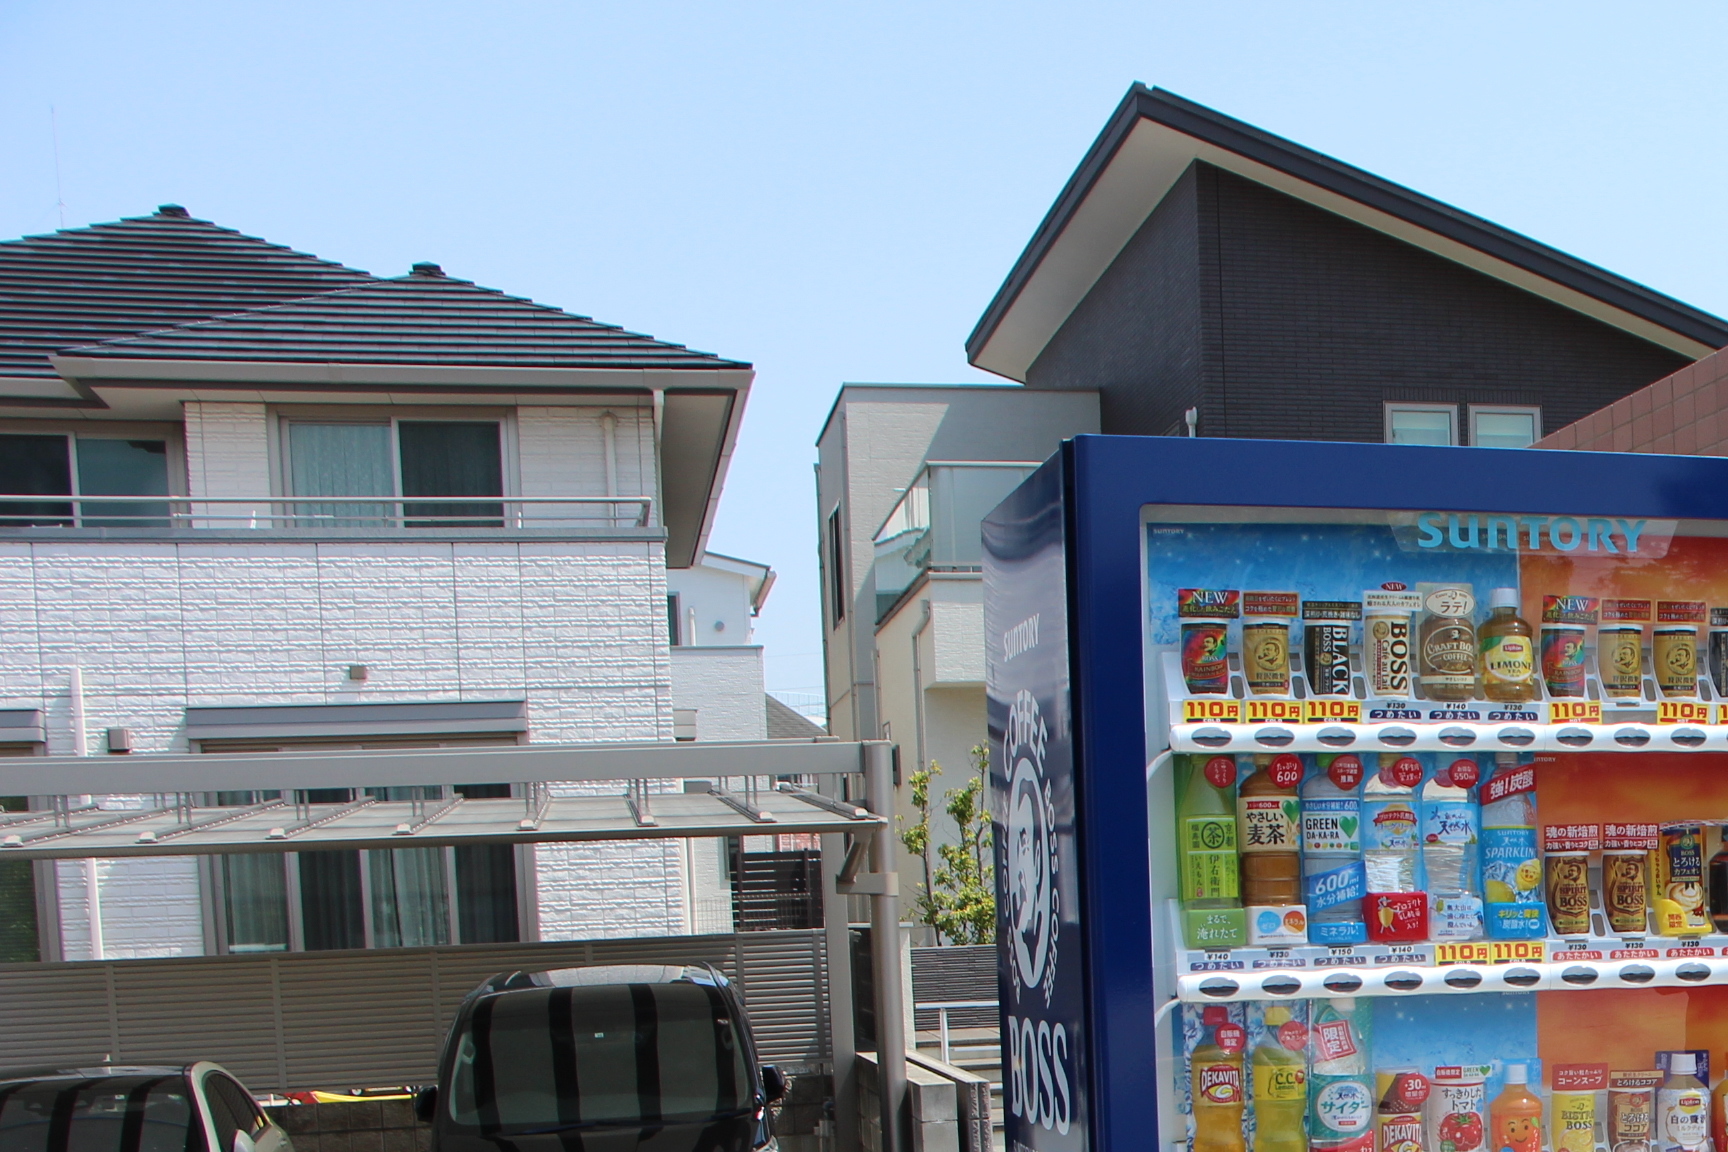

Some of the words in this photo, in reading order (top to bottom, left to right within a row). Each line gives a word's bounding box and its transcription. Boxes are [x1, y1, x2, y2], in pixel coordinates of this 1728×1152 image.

[1417, 512, 1647, 553] SUNTORY
[1386, 583, 1404, 591] NEW
[1192, 591, 1228, 604] NEW
[1440, 601, 1467, 615] ラテ!
[1556, 599, 1588, 611] NEW
[1004, 613, 1040, 662] SUNTORY
[1323, 627, 1331, 652] BOSS
[1427, 642, 1459, 654] CRAFT
[1332, 627, 1349, 694] BLACK
[1390, 622, 1408, 692] BOSS
[1443, 653, 1468, 662] COFFEE
[1187, 702, 1238, 717] 110円
[1249, 702, 1300, 718] 110円
[1308, 702, 1359, 717] 110円
[1375, 711, 1417, 719] つめたい
[1434, 711, 1479, 719] つめたい
[1552, 703, 1599, 717] 110円
[1661, 703, 1707, 718] 110円
[1493, 712, 1534, 720] つめたい
[1004, 689, 1048, 782] COFFEE
[1277, 772, 1298, 782] 600
[1246, 812, 1284, 822] やさしい
[1045, 779, 1058, 875] BOSS
[1305, 818, 1338, 830] GREEN
[1438, 820, 1472, 836] 天然水
[1206, 826, 1222, 845] 茶
[1225, 823, 1234, 847] 京都
[1247, 824, 1285, 845] 麦茶
[1546, 826, 1598, 838] 魂の新焙煎
[1605, 825, 1657, 837] 魂の新焙煎
[1546, 841, 1588, 849] 力強い香りとコク
[1605, 840, 1646, 848] 力強い香りとコク
[1673, 857, 1700, 867] とろける
[1210, 855, 1220, 897] 伊右衛門
[1560, 885, 1587, 895] SPIRIT
[1617, 884, 1644, 894] SPIRIT
[1316, 885, 1359, 908] 水分補給!
[1560, 895, 1587, 907] BOSS
[1617, 894, 1644, 906] BOSS
[1321, 926, 1359, 936] ミネラル!
[1043, 887, 1060, 1009] COFFEE
[1439, 945, 1487, 960] 110円
[1494, 943, 1542, 958] 110円
[1615, 950, 1655, 958] あたたかい
[1671, 948, 1710, 956] あたたかい
[1318, 957, 1361, 966] つめたい
[1380, 954, 1422, 963] つめたい
[1557, 952, 1598, 960] あたたかい
[1195, 962, 1240, 970] つめたい
[1324, 1027, 1342, 1054] 限定
[1008, 1016, 1071, 1136] BOSS
[1201, 1069, 1240, 1090] DEKAVITA
[1275, 1073, 1296, 1085] C.C.
[1558, 1076, 1603, 1085] コーンスープ
[1216, 1085, 1232, 1098] C
[1442, 1088, 1482, 1099] すっきりした
[1321, 1101, 1369, 1114] サイダー
[1452, 1100, 1476, 1110] トマト
[1621, 1113, 1648, 1123] とろける
[1566, 1121, 1592, 1130] BOSS
[1624, 1123, 1646, 1132] ココア
